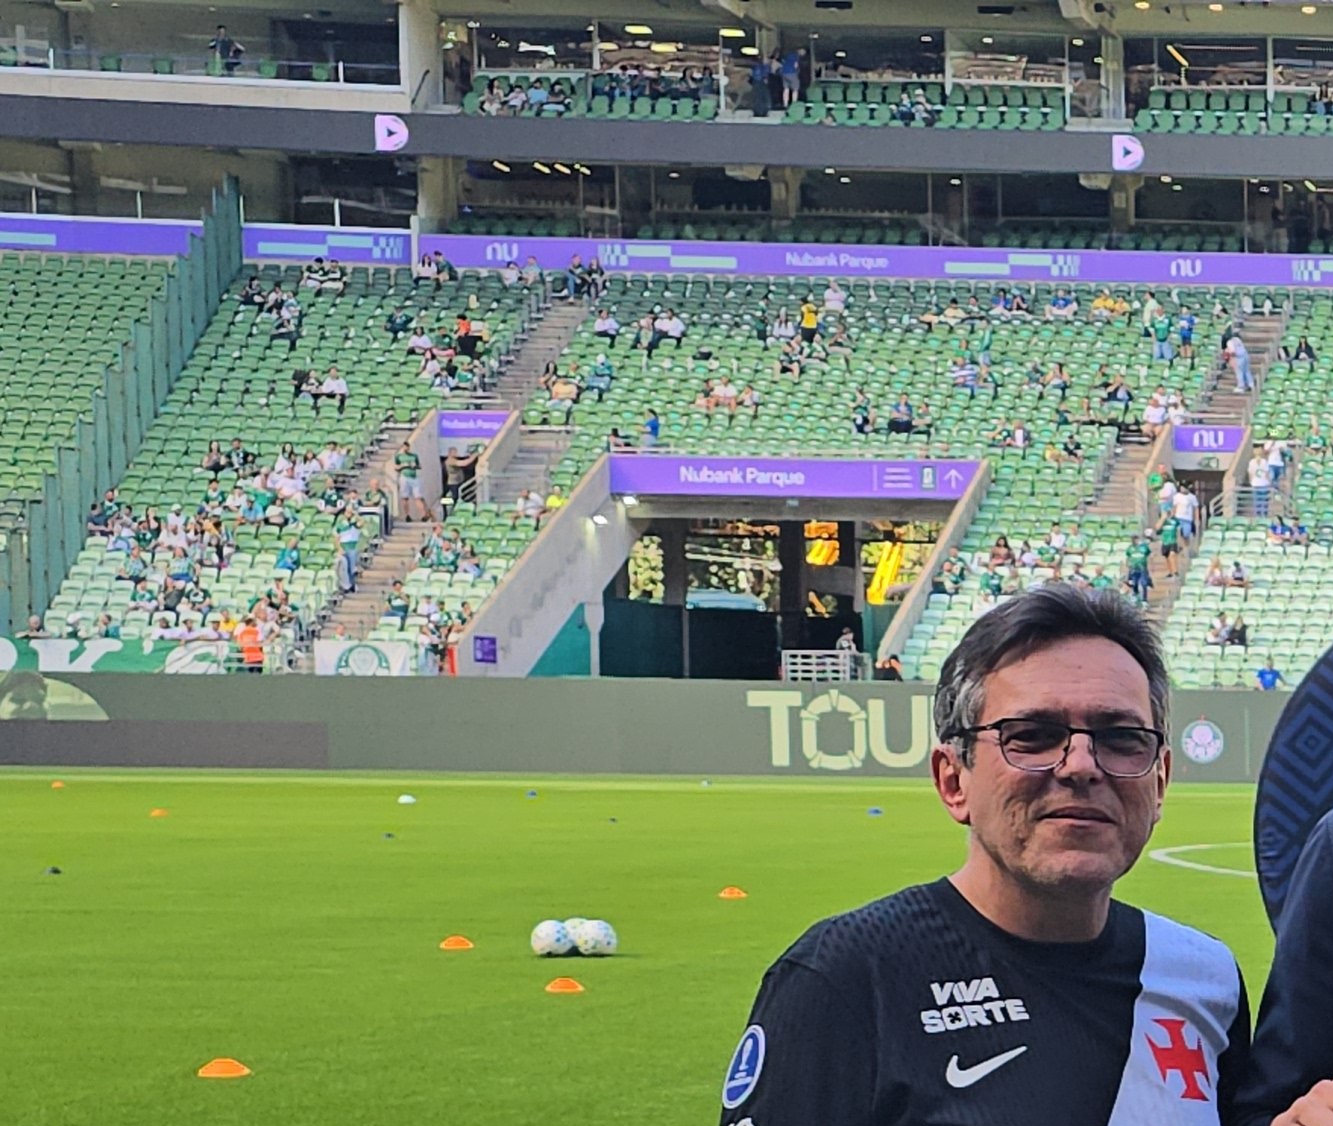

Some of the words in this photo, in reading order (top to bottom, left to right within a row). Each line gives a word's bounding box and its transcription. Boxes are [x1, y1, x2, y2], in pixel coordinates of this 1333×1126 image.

[785, 252, 838, 267] Nubank
[839, 253, 890, 270] Parque
[679, 465, 743, 484] Nubank
[745, 467, 805, 488] Parque
[747, 688, 937, 771] TOU
[930, 977, 1000, 1006] VIVA
[921, 999, 1030, 1033] SORTE
